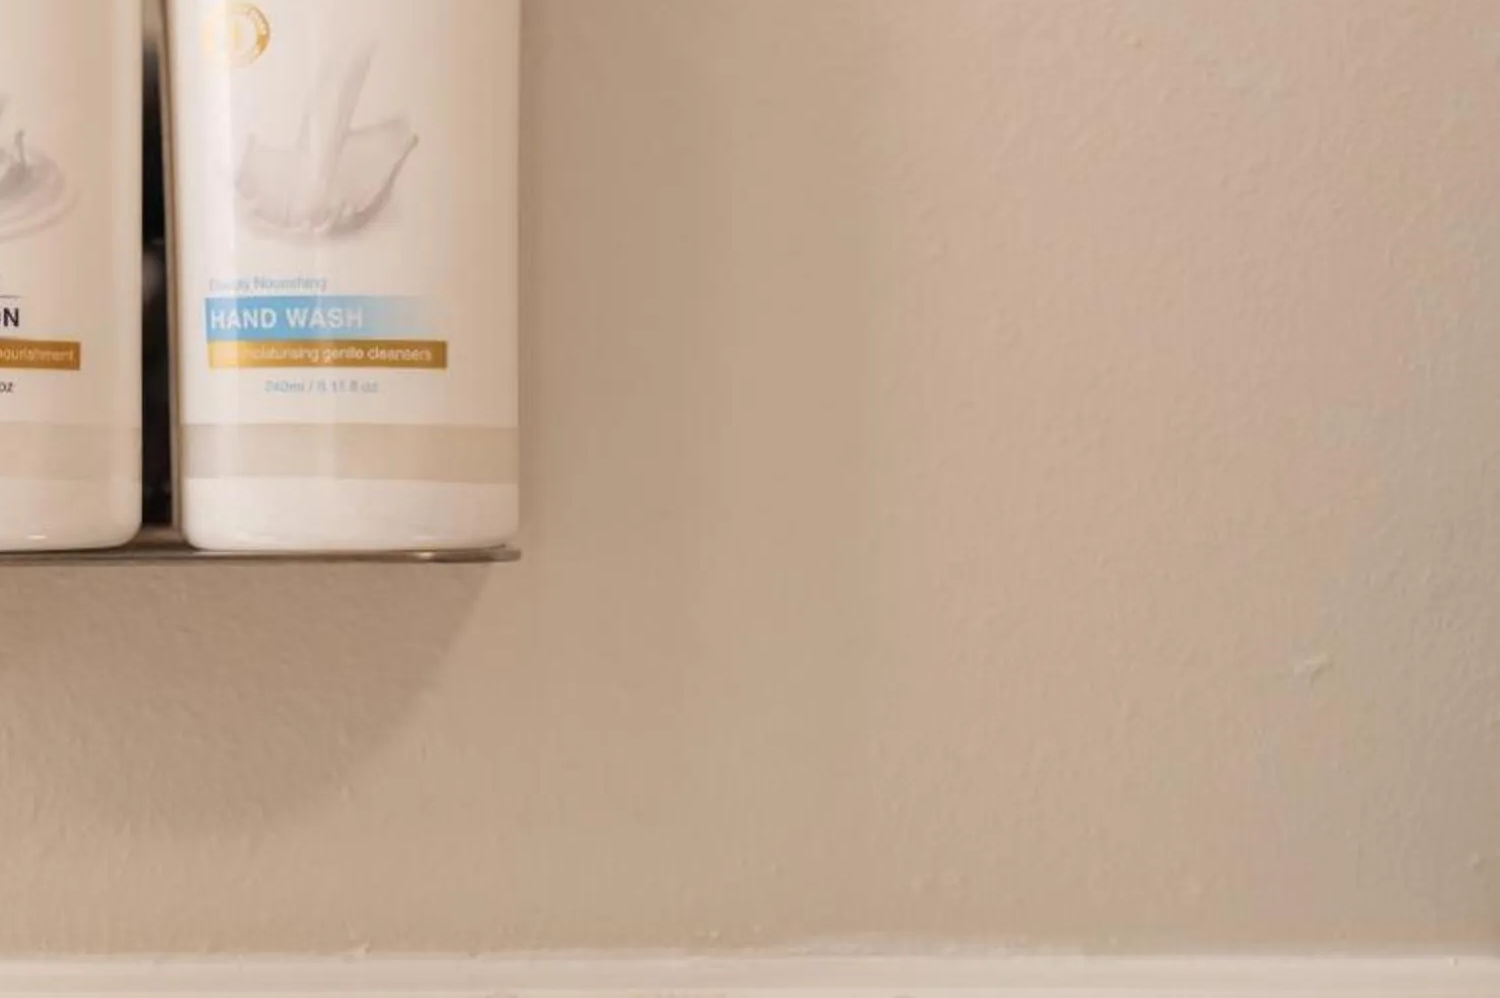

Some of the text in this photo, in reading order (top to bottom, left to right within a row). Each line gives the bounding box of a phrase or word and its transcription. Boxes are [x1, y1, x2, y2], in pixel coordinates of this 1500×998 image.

[210, 306, 364, 330] HAND WASH
[241, 345, 320, 364] oisturising
[322, 346, 365, 365] gentle
[366, 345, 433, 362] cleansers
